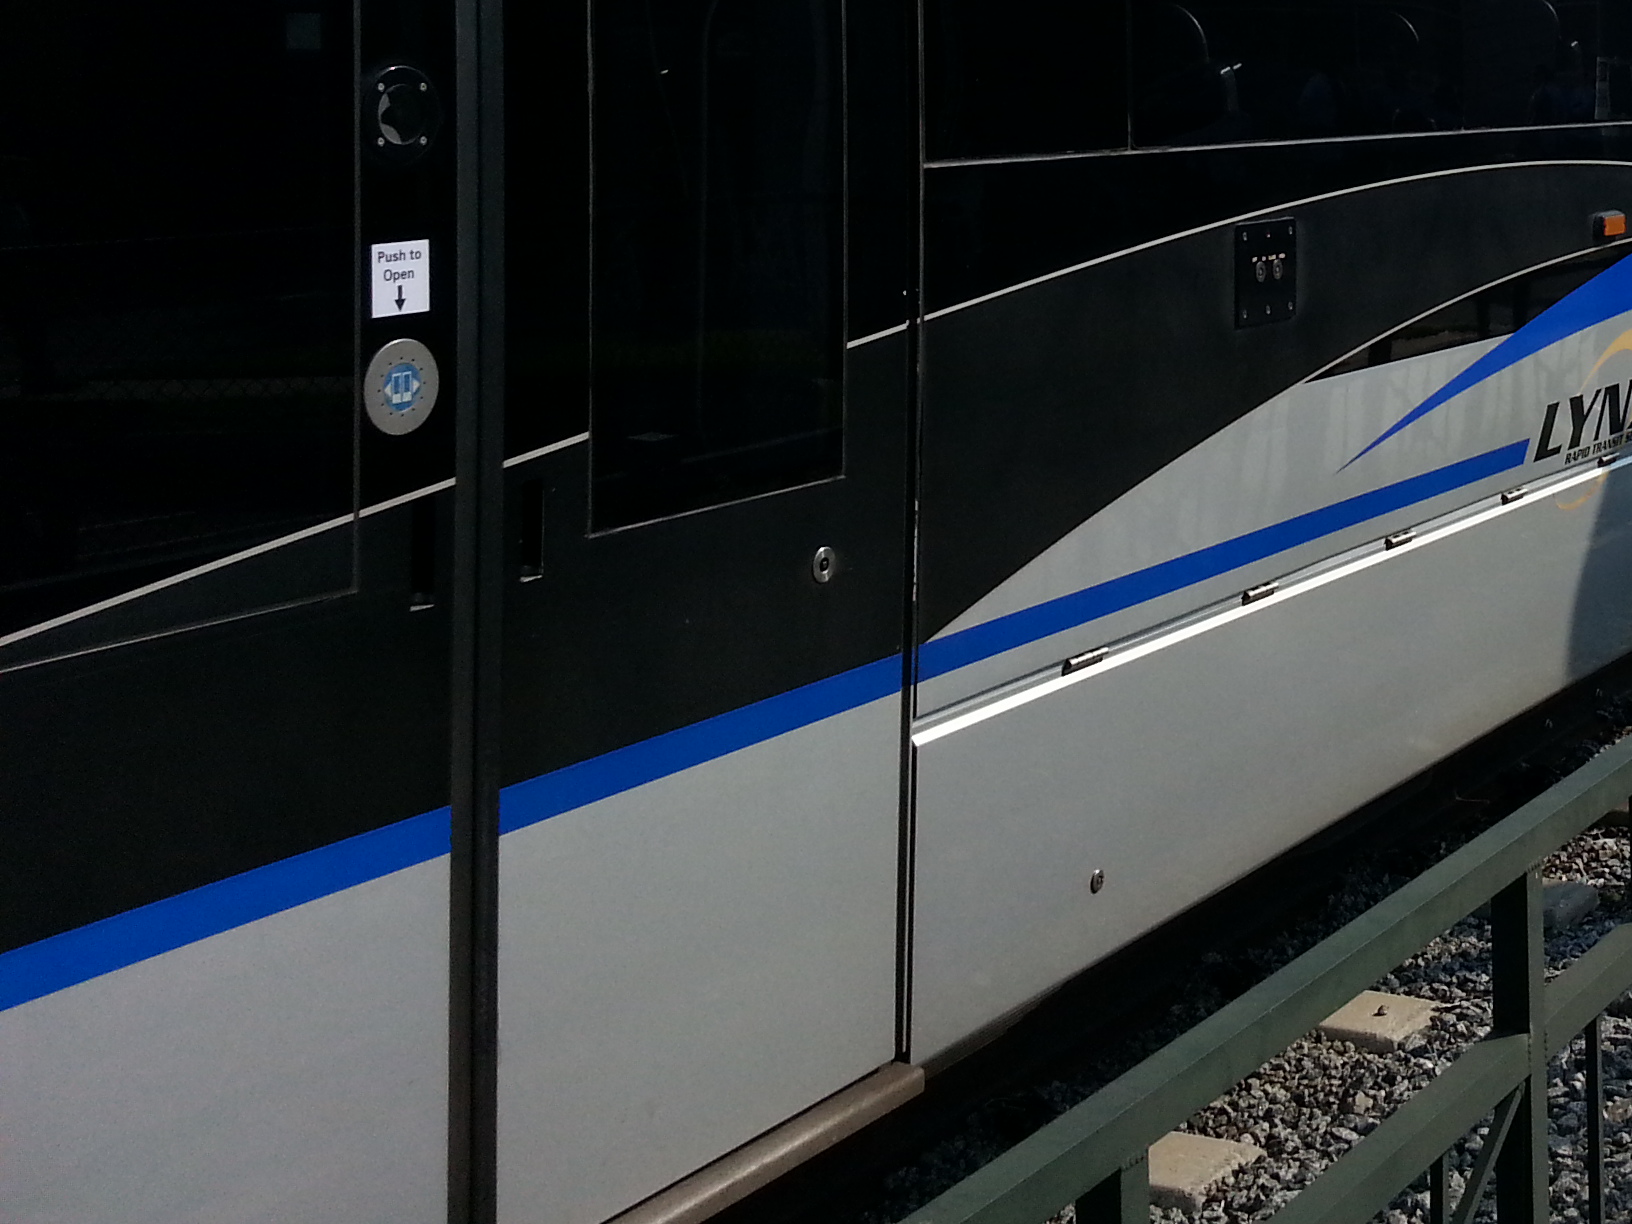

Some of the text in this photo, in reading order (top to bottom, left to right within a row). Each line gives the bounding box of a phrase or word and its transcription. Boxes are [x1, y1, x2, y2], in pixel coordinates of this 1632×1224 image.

[377, 249, 422, 263] Push to
[383, 268, 415, 283] Open
[1564, 446, 1591, 465] RAPID
[1592, 435, 1623, 454] TRANSIT
